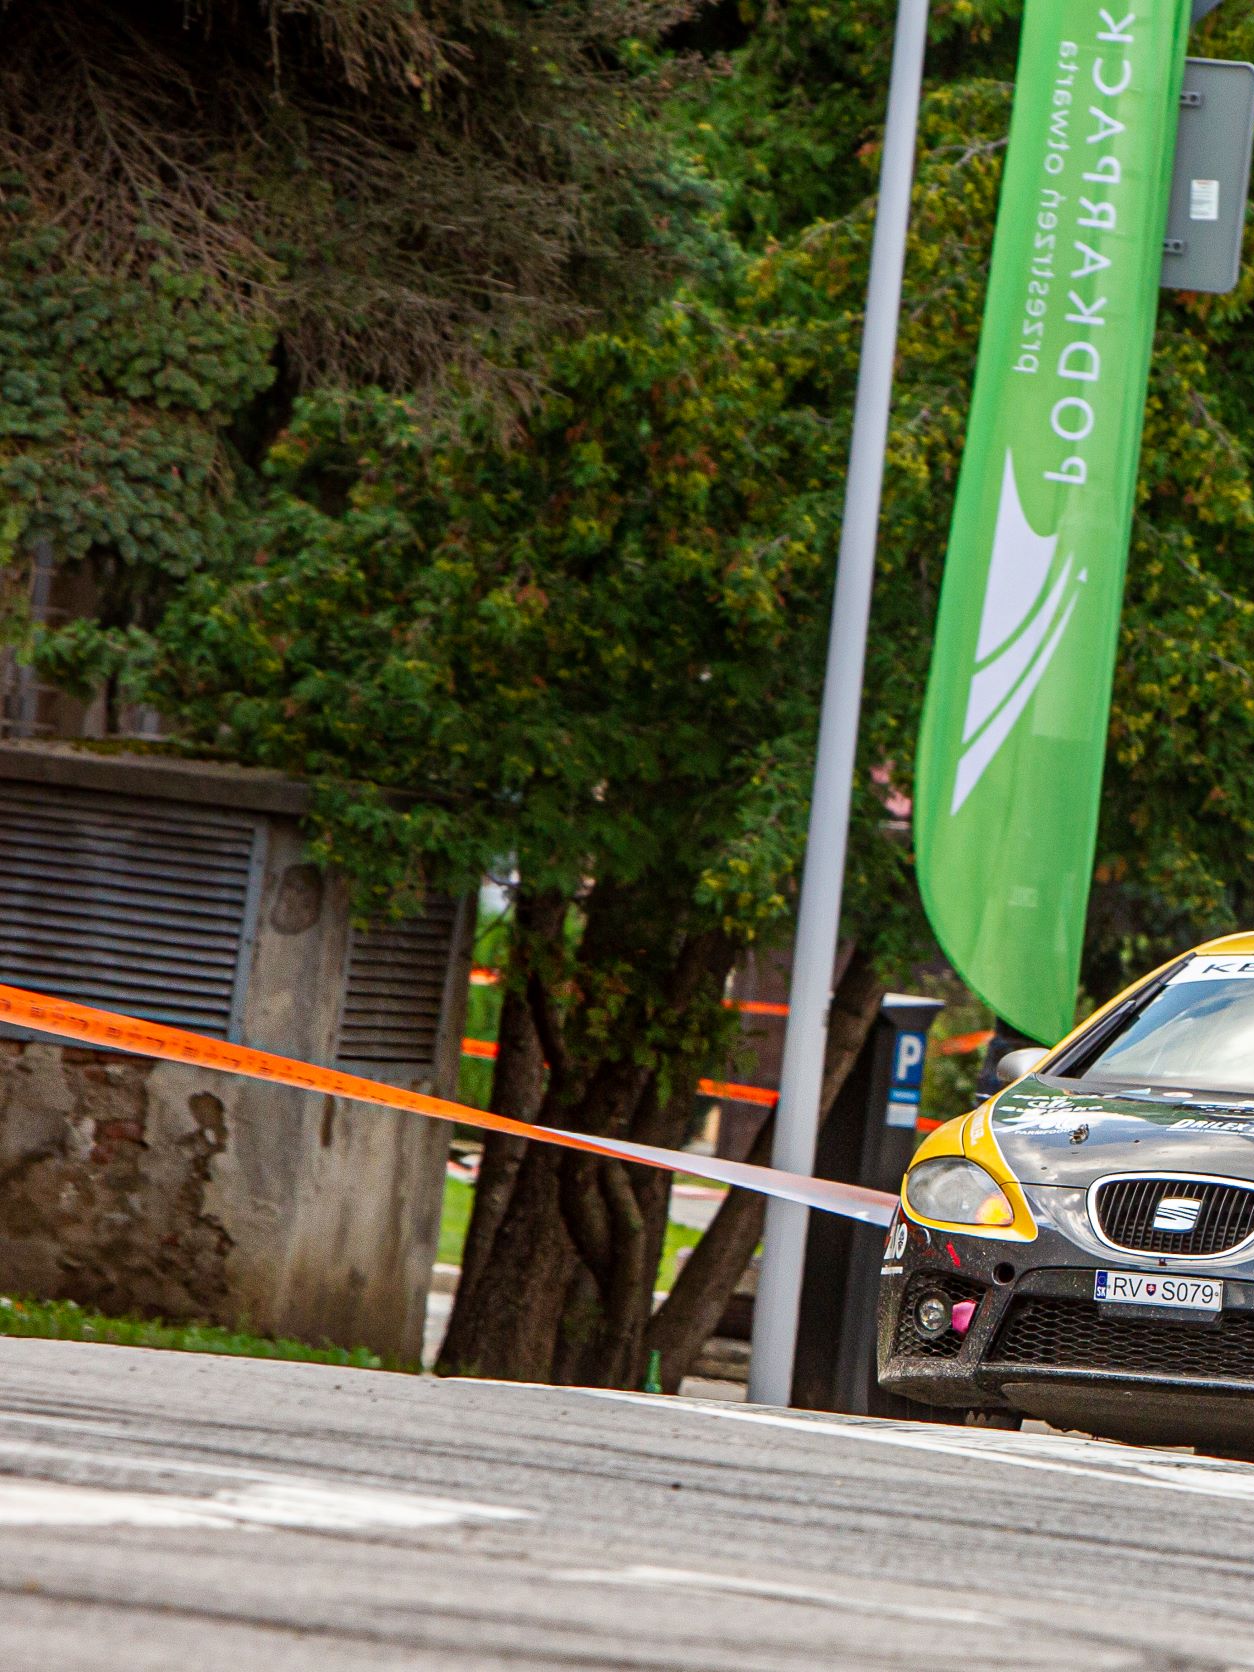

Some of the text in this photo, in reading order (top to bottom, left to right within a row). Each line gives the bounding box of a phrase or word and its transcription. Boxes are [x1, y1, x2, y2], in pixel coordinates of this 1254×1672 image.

[896, 1034, 922, 1080] P
[1113, 1277, 1143, 1298] RV
[1161, 1280, 1214, 1304] S079
